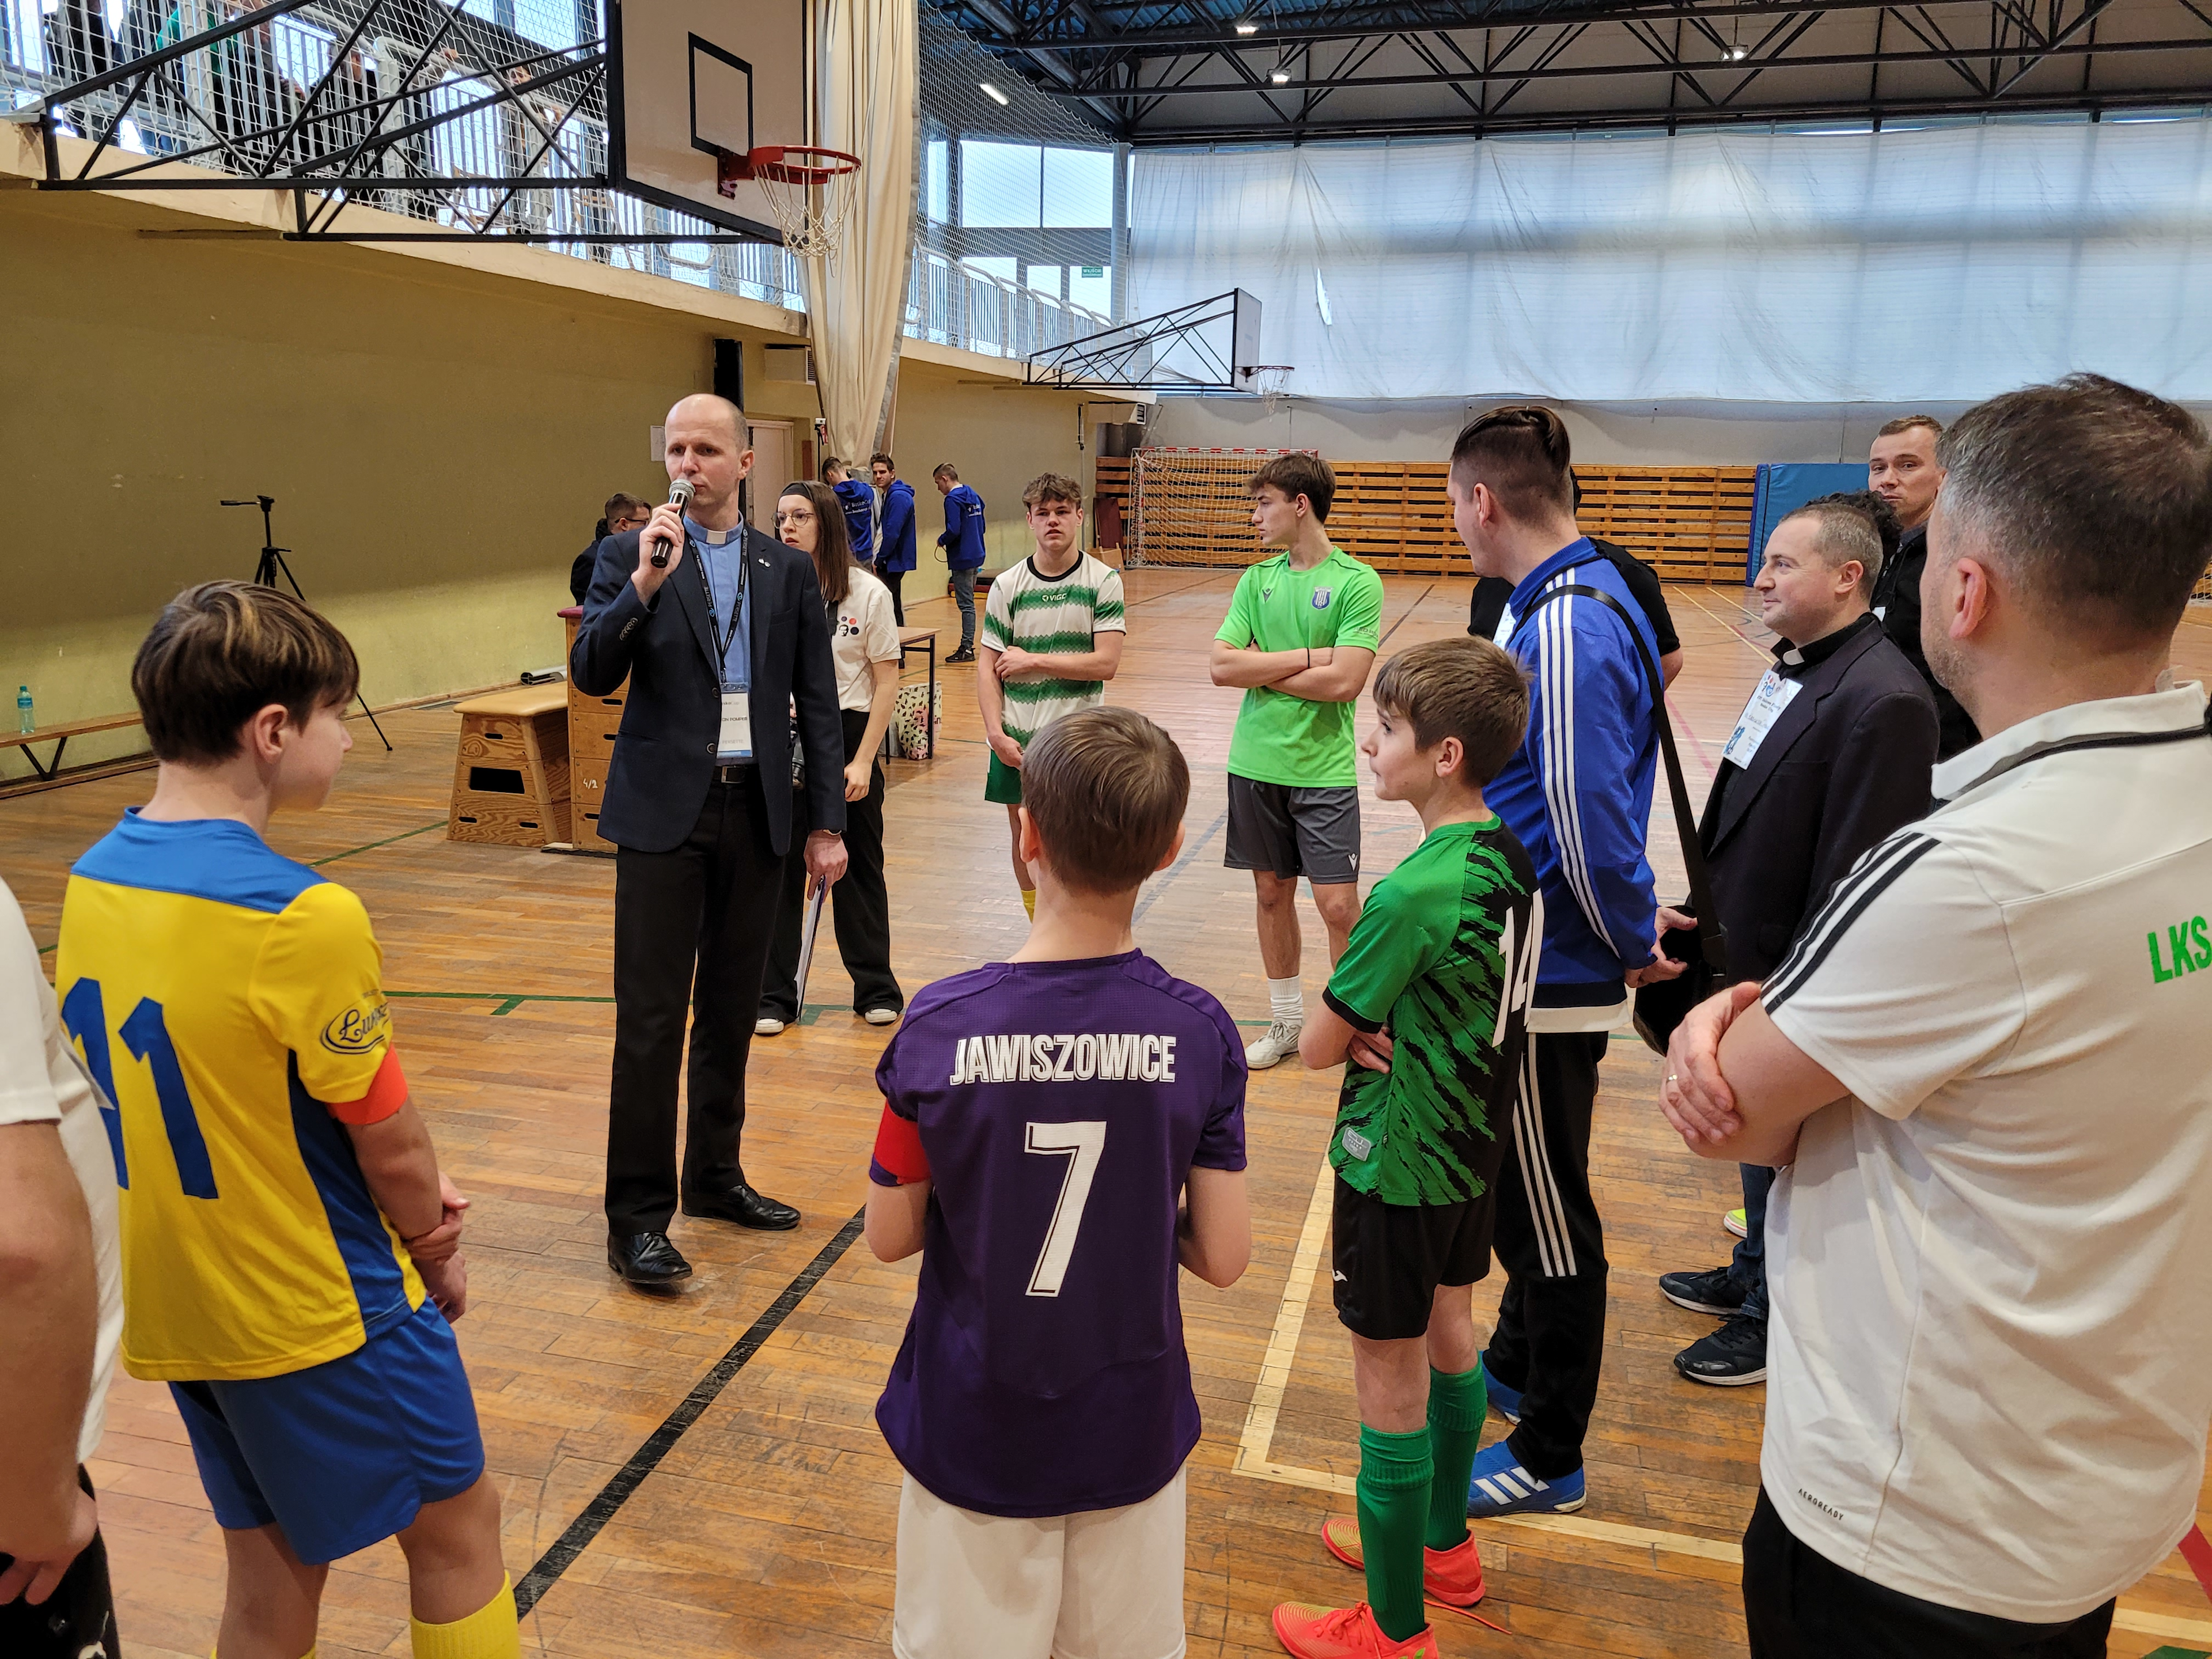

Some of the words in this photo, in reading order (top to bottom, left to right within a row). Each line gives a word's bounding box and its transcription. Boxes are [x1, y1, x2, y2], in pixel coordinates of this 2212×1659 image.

[583, 778, 599, 789] 4/2
[2147, 915, 2212, 984] LKS
[60, 977, 219, 1199] 11
[949, 1033, 1176, 1086] JAWISZOWICE
[1024, 1120, 1107, 1298] 7
[1798, 1488, 1844, 1521] AEROREADY
